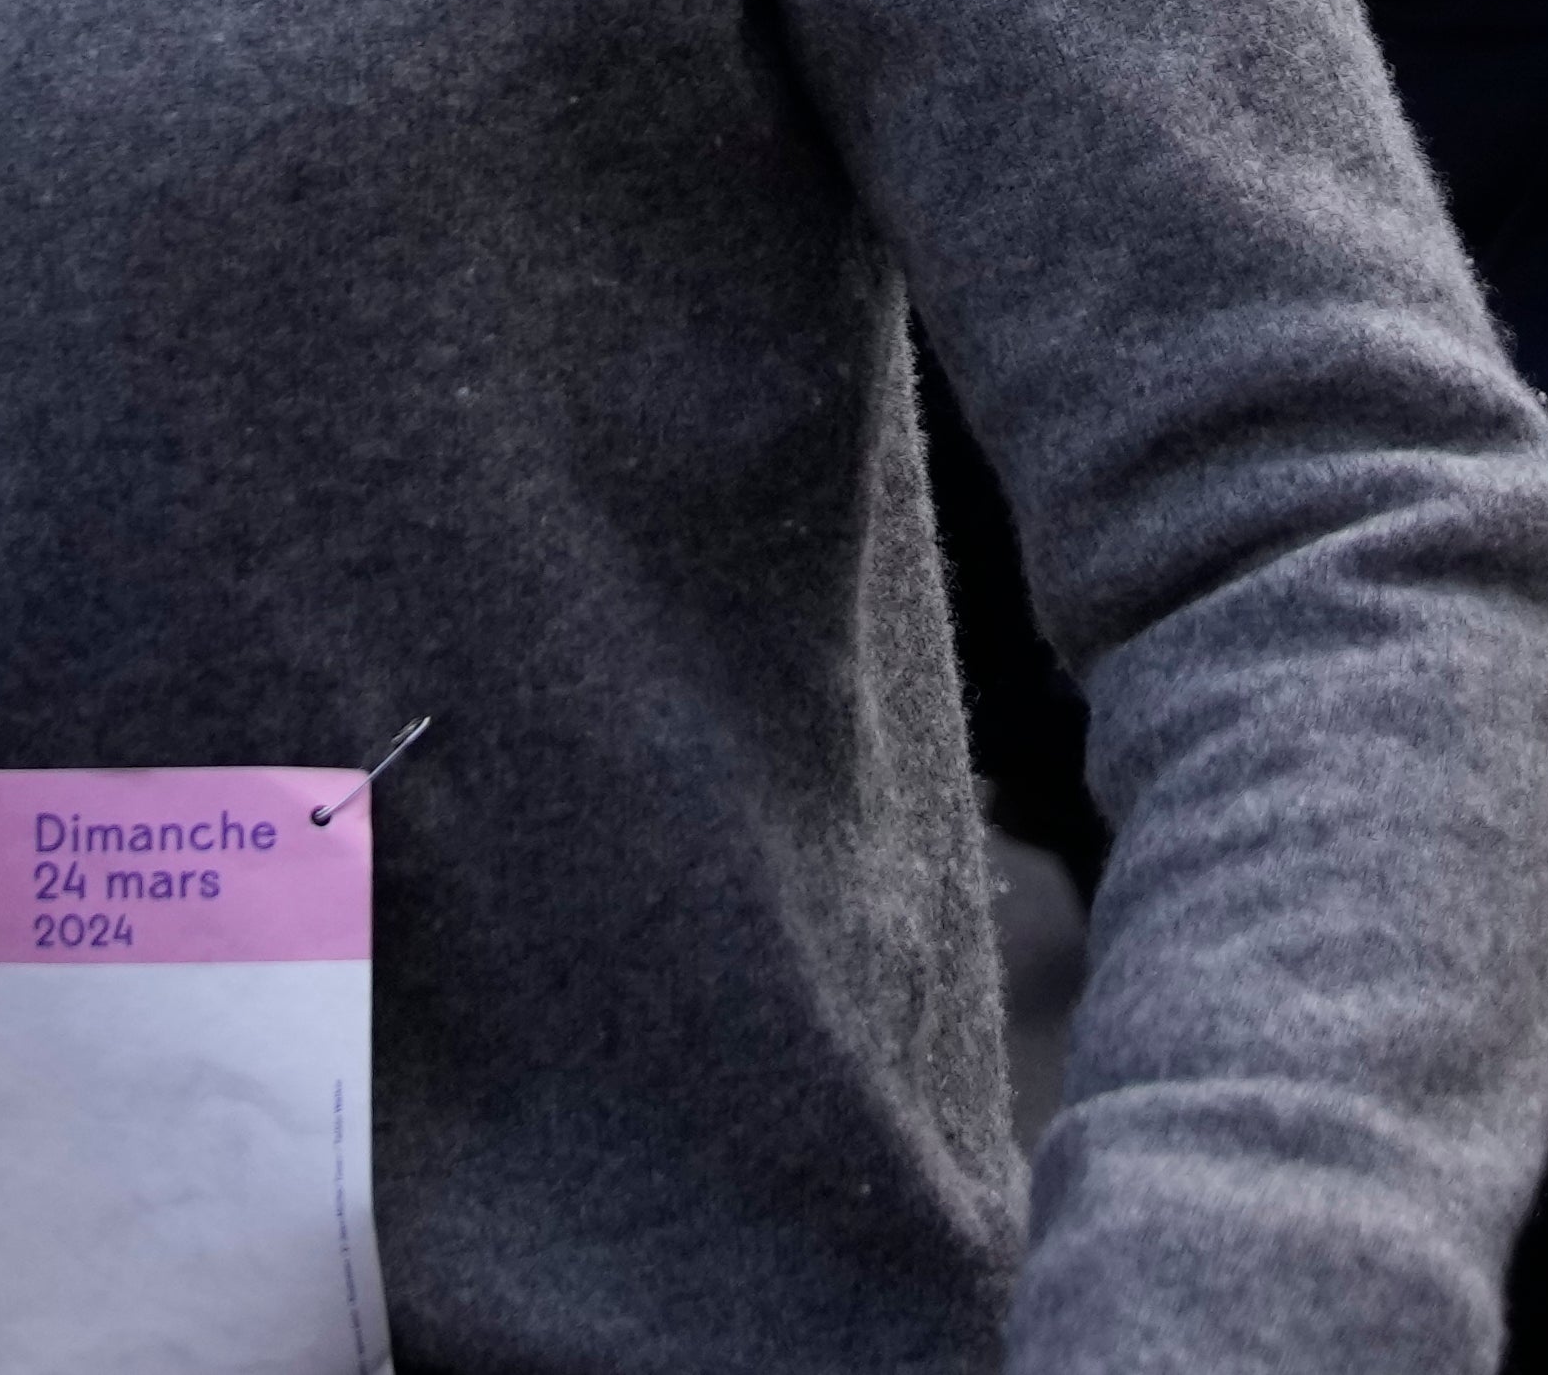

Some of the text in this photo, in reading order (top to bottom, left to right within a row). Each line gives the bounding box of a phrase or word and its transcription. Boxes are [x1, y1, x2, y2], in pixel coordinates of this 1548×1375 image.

[35, 809, 278, 853] Dimanche
[33, 860, 221, 900] 24 mars
[33, 912, 134, 948] 2024
